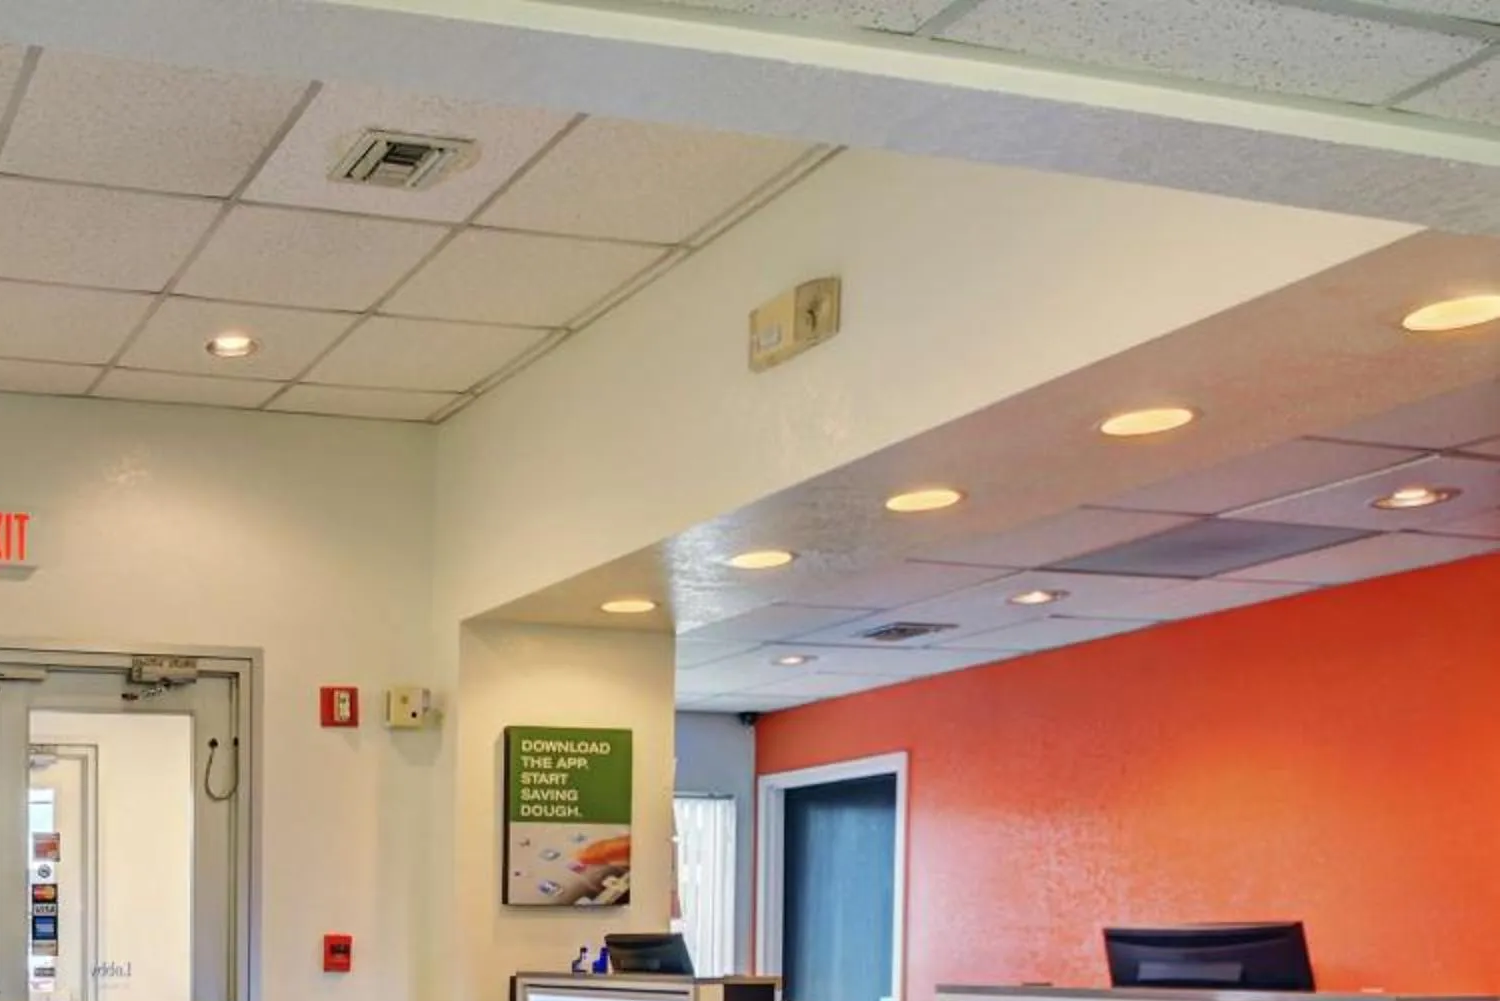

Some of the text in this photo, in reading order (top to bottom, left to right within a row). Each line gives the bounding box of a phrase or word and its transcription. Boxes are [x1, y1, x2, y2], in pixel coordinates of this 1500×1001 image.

[521, 739, 611, 755] DOWNLOAD
[521, 756, 553, 769] THE
[520, 772, 569, 786] START
[520, 787, 579, 801] SAVING
[520, 804, 583, 818] DOUGH.
